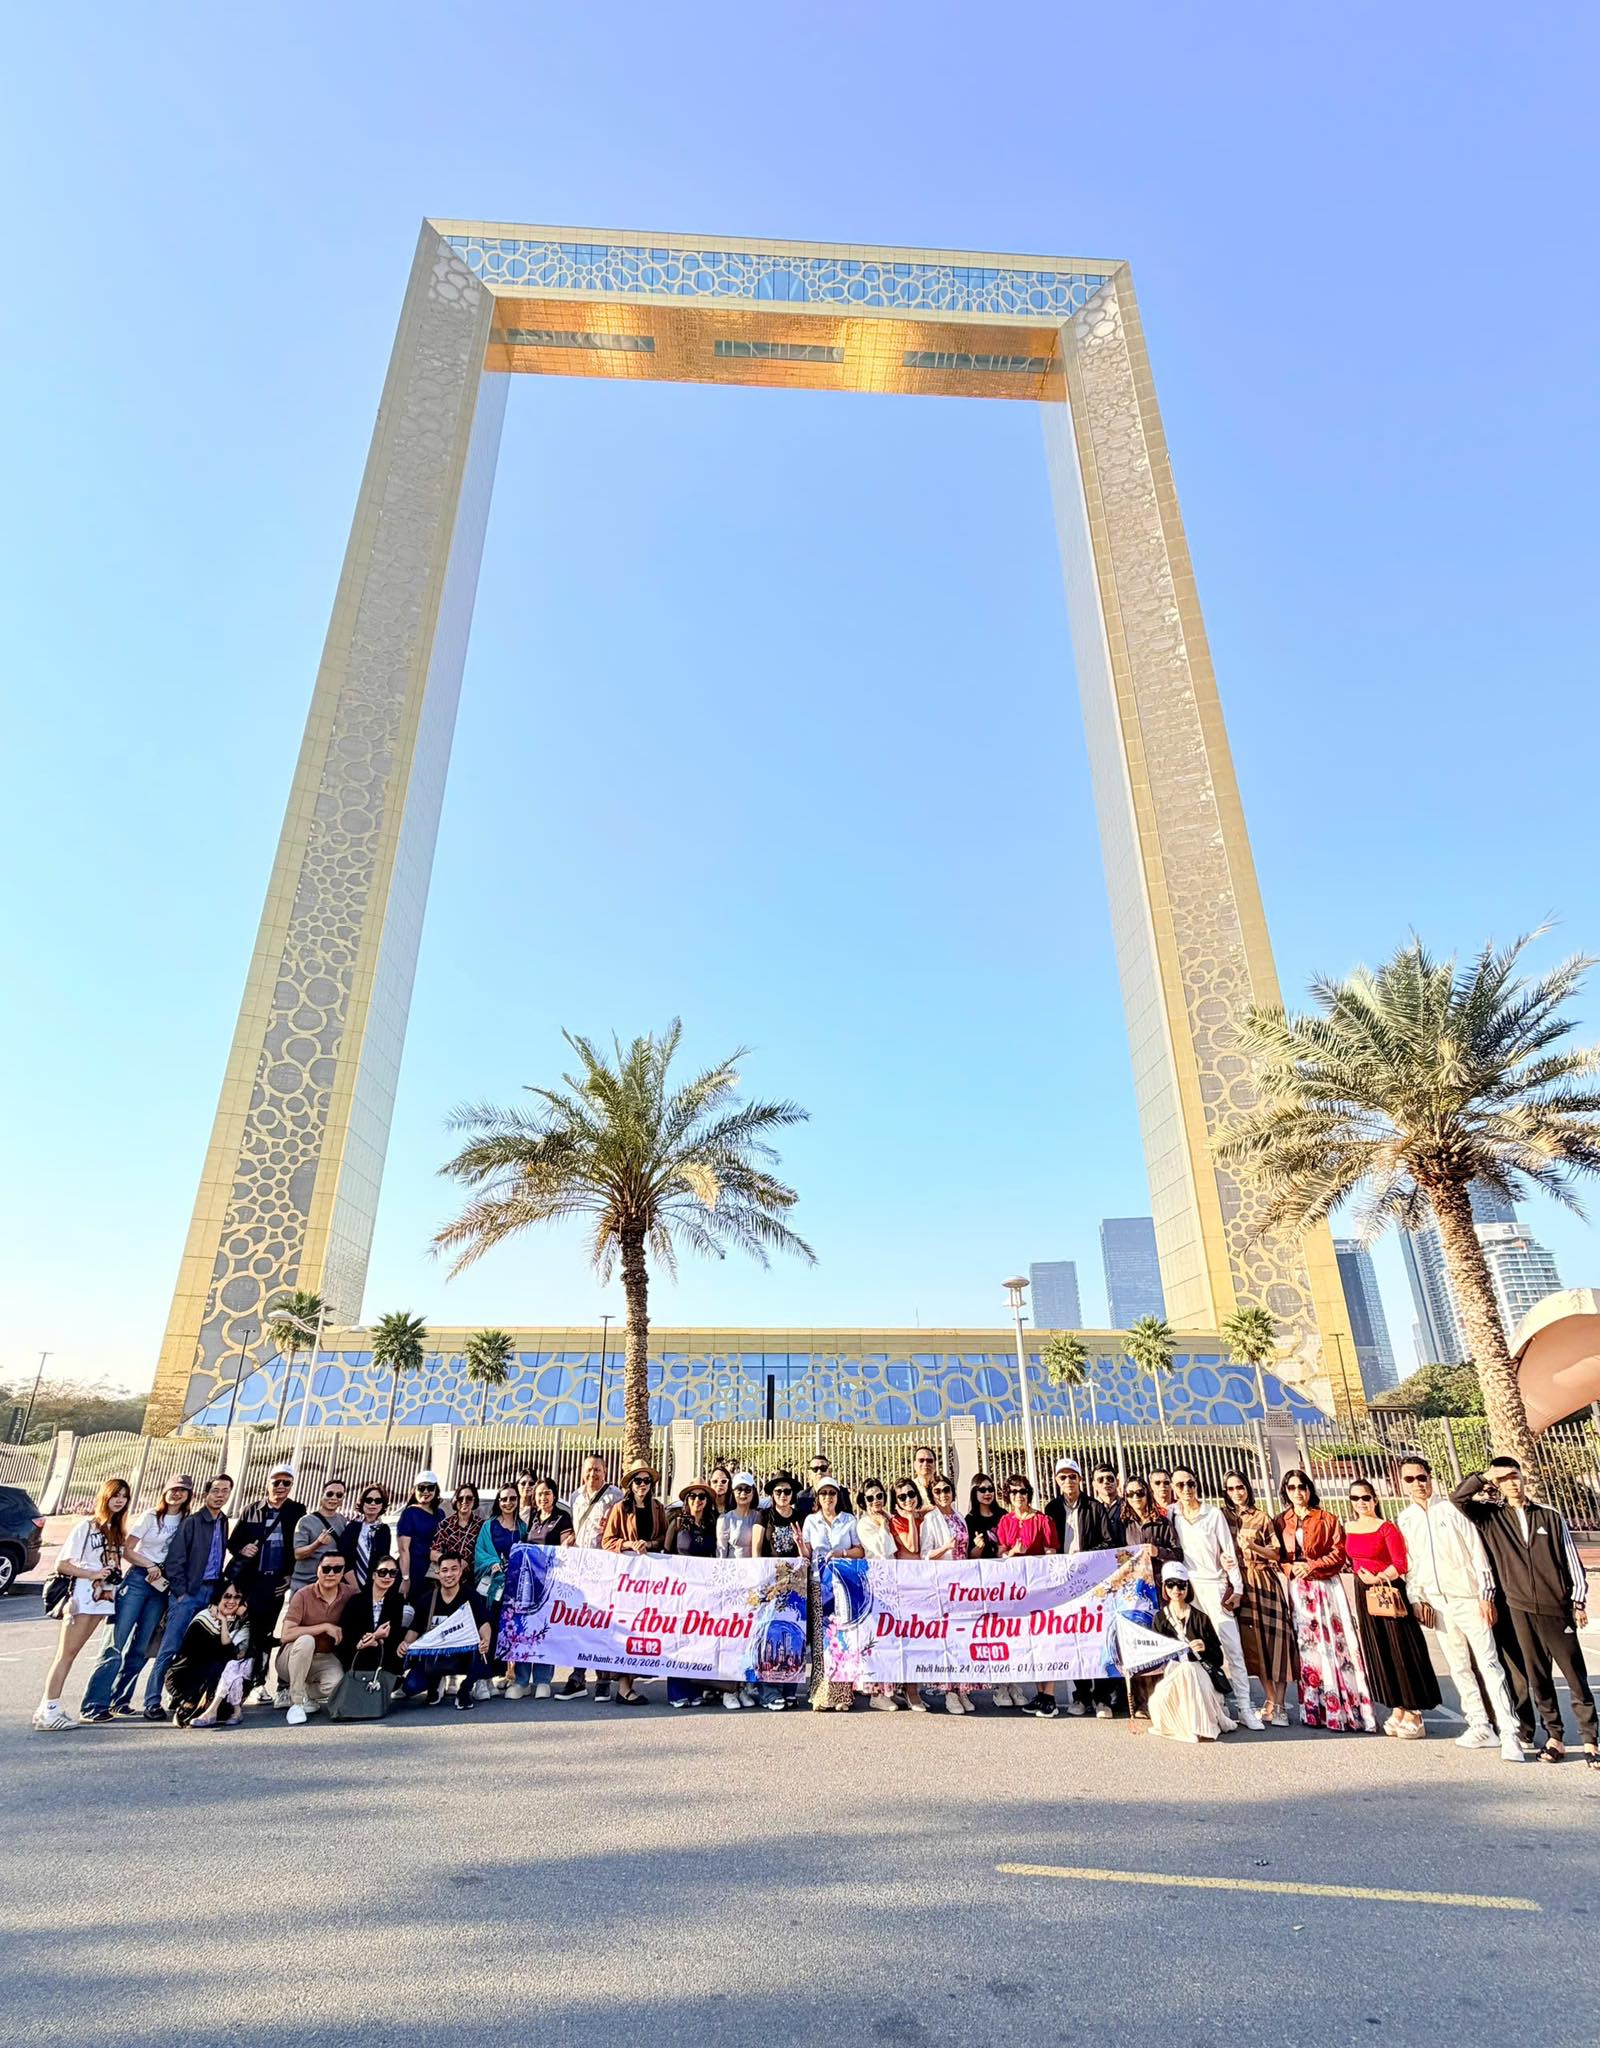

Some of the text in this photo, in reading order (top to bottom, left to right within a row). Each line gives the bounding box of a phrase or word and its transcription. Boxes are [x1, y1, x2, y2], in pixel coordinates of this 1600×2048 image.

[617, 1573, 687, 1596] Travel to
[948, 1581, 1027, 1602] Travel to
[550, 1600, 614, 1629] Dubai
[631, 1607, 677, 1633] Abu
[682, 1609, 753, 1638] Dhabi
[876, 1612, 949, 1639] Dubai
[972, 1612, 1021, 1639] Abu
[1030, 1604, 1103, 1636] Dhabi
[444, 1623, 463, 1636] DUBAI
[630, 1639, 658, 1654] XE 02
[975, 1645, 1004, 1660] XE 01
[615, 1656, 660, 1668] 24/02/2026
[666, 1659, 713, 1672] 01/03/2026
[959, 1663, 1010, 1675] 24/02/026
